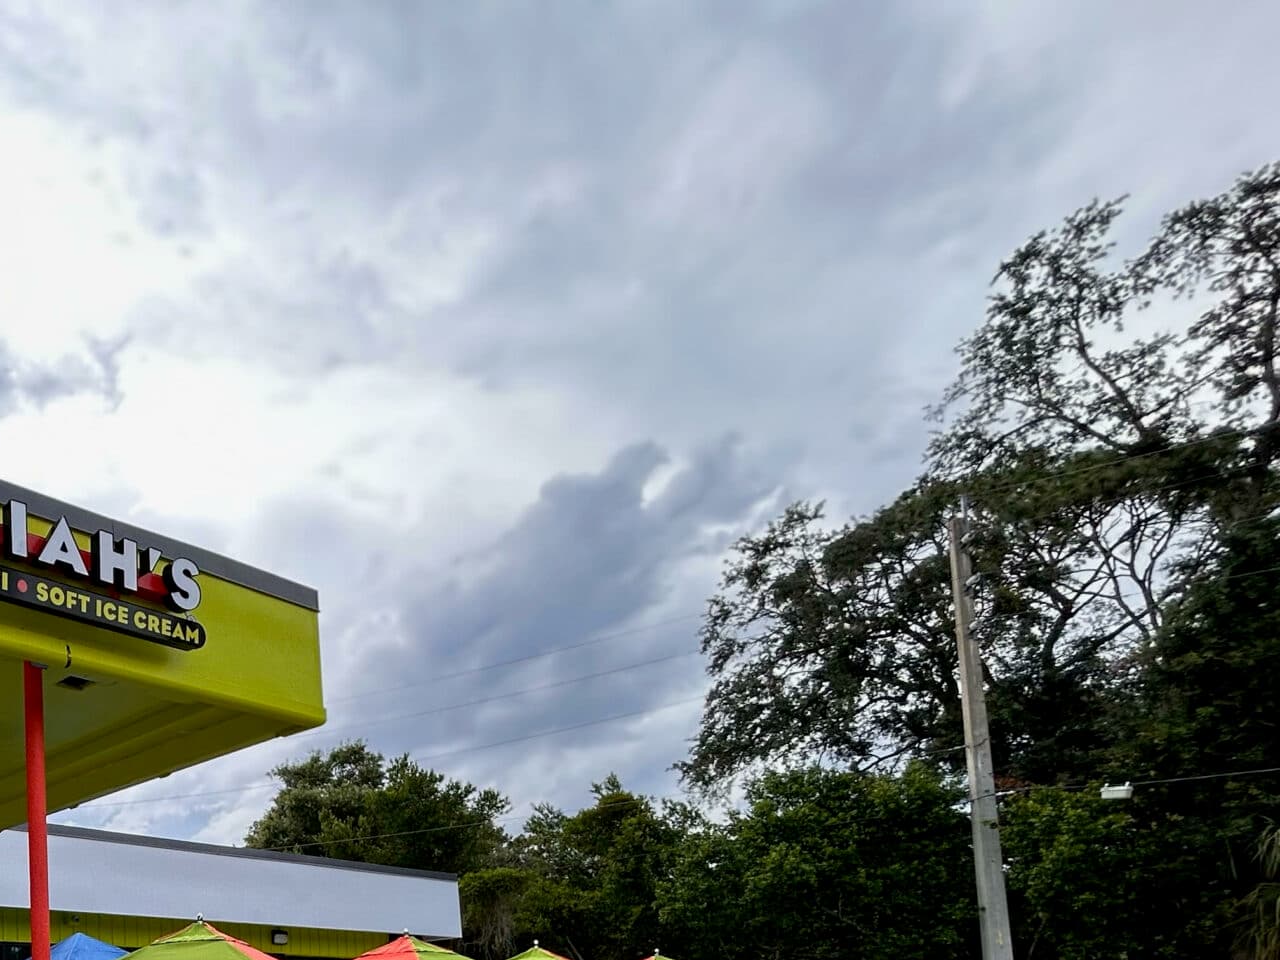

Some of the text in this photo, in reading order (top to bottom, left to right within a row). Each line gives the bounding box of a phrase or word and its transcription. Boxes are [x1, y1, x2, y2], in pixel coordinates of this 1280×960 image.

[36, 582, 91, 613] SOFT
[95, 599, 129, 625] ICE
[133, 610, 200, 644] CREAM
